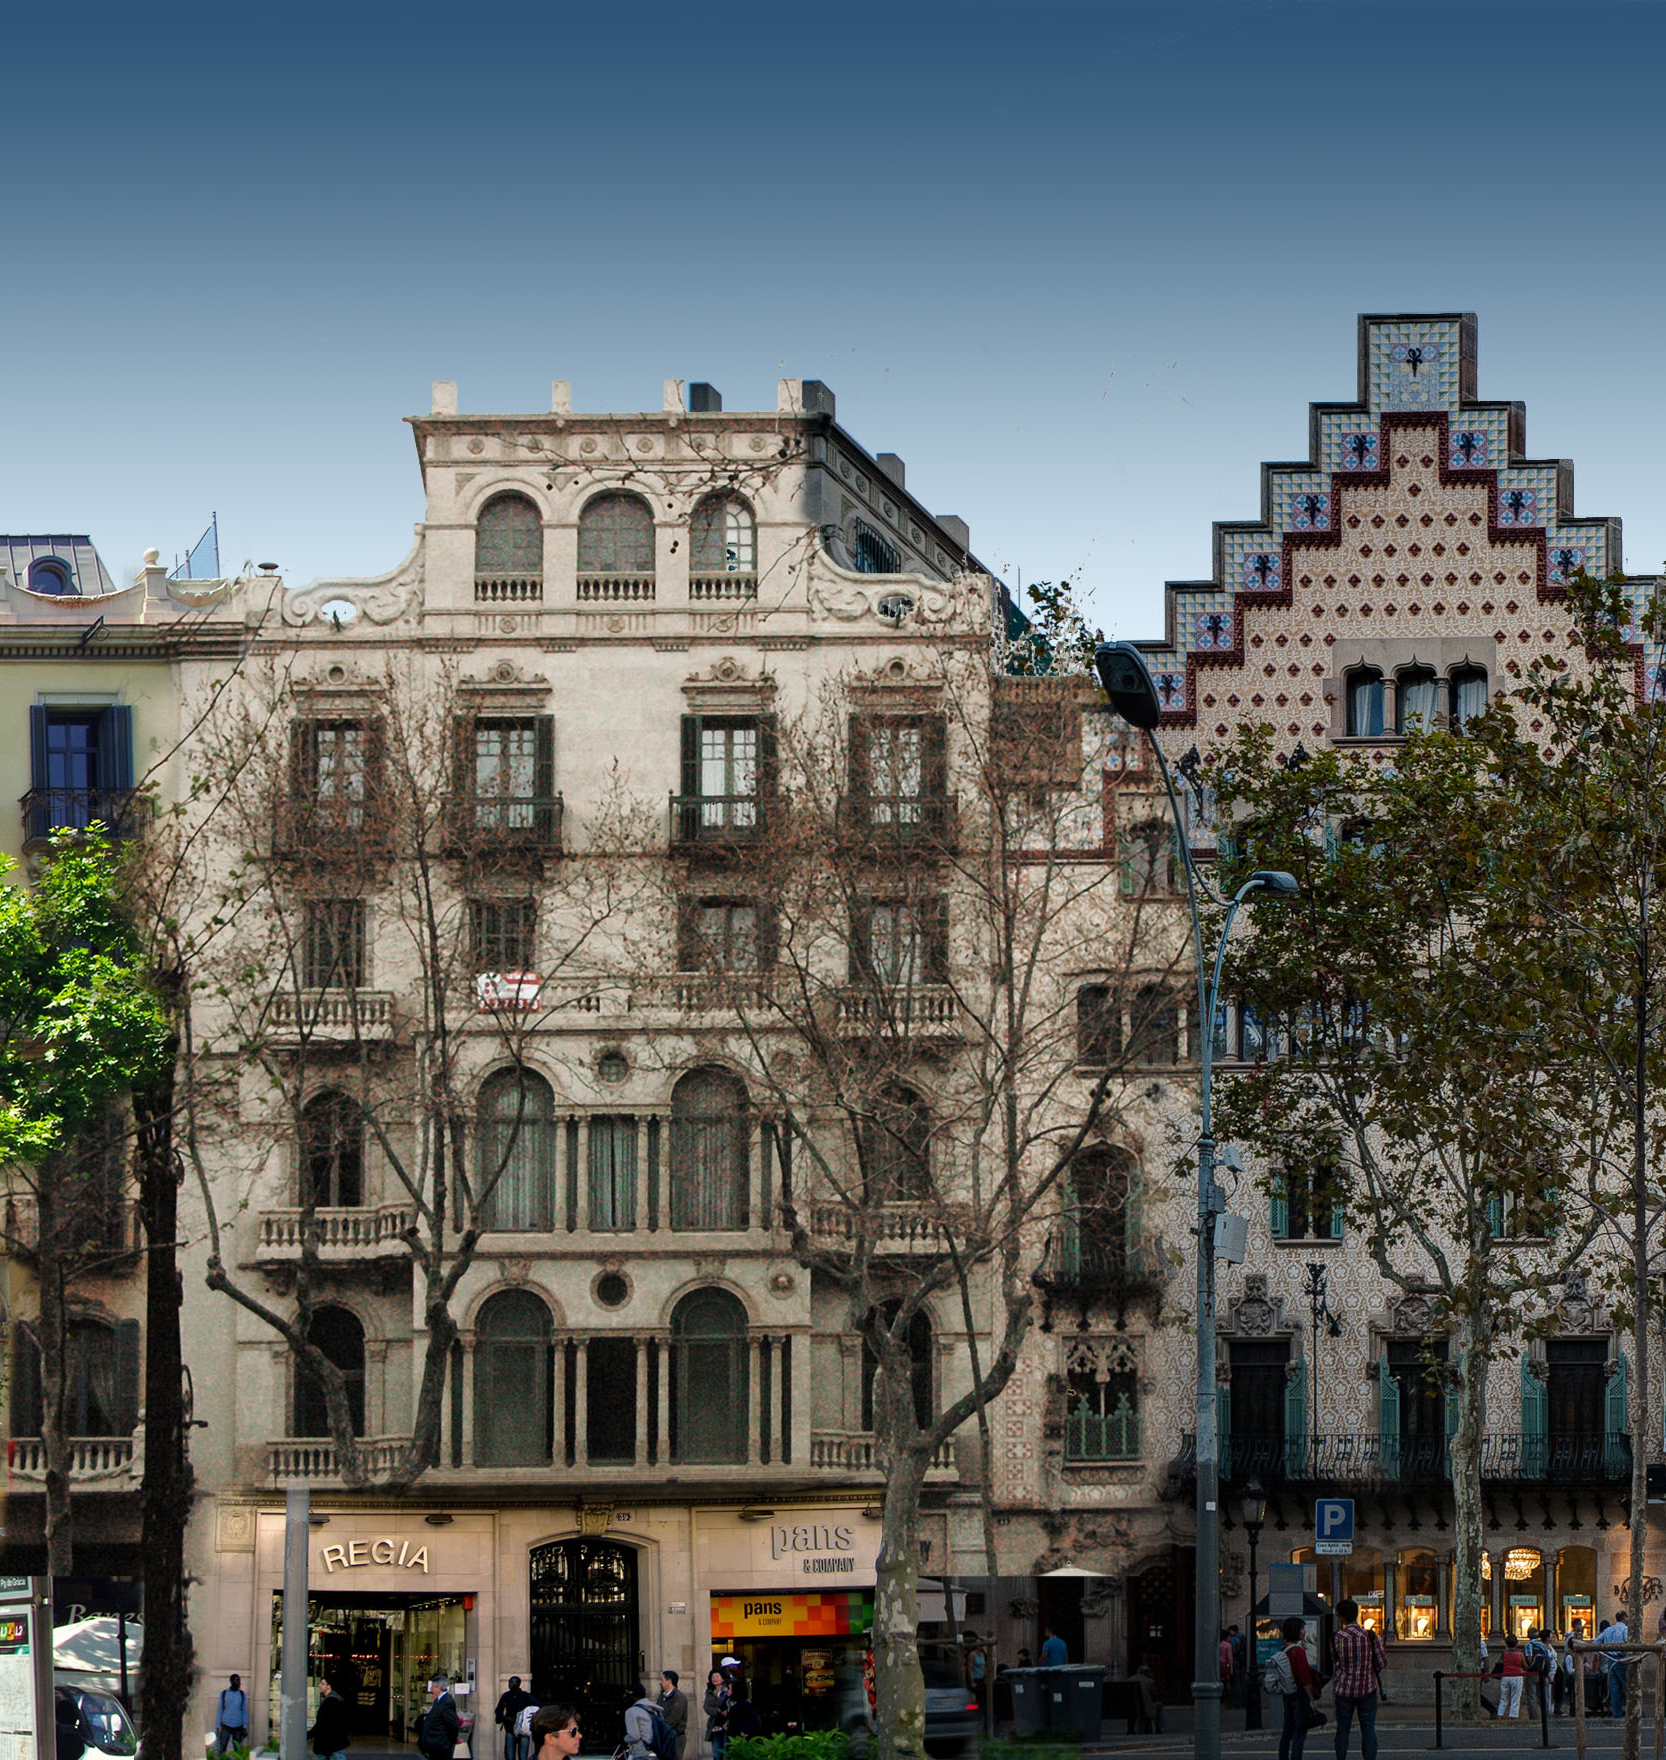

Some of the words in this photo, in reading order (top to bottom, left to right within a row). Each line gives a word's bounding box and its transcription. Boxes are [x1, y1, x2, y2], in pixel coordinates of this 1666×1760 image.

[1324, 1504, 1346, 1535] P
[771, 1525, 854, 1560] pans
[322, 1538, 429, 1574] REGIA
[803, 1558, 811, 1573] &
[813, 1557, 855, 1573] COMPANY
[744, 1601, 782, 1619] pans
[762, 1618, 782, 1626] COMPANY
